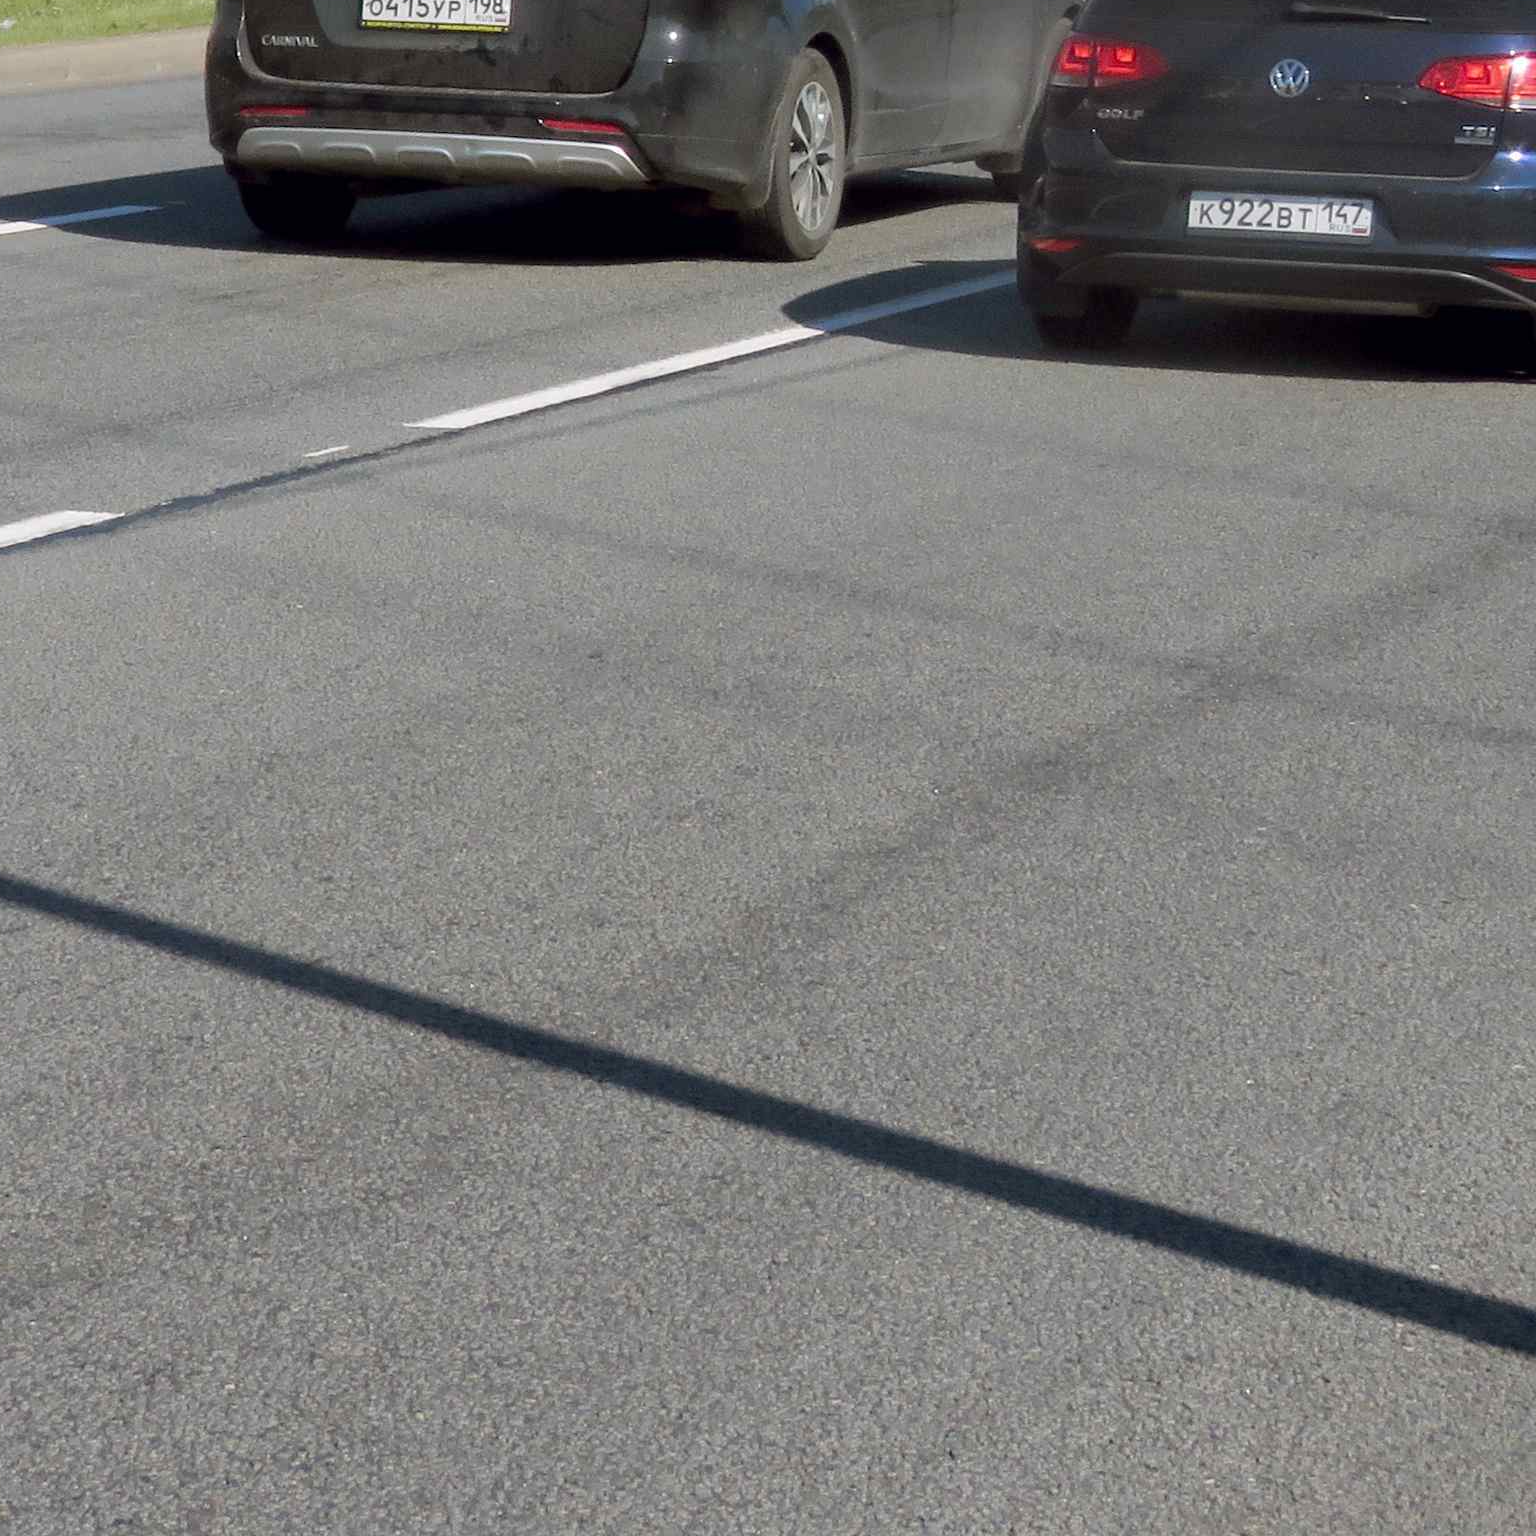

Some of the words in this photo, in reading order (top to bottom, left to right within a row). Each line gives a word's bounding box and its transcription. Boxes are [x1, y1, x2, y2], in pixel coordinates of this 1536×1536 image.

[261, 34, 319, 48] CARNIVAL
[1097, 107, 1145, 121] GOLF
[1461, 125, 1497, 138] TSI
[1198, 197, 1313, 230] К922ВТ
[1322, 202, 1362, 225] 147
[1329, 224, 1352, 234] RUS
